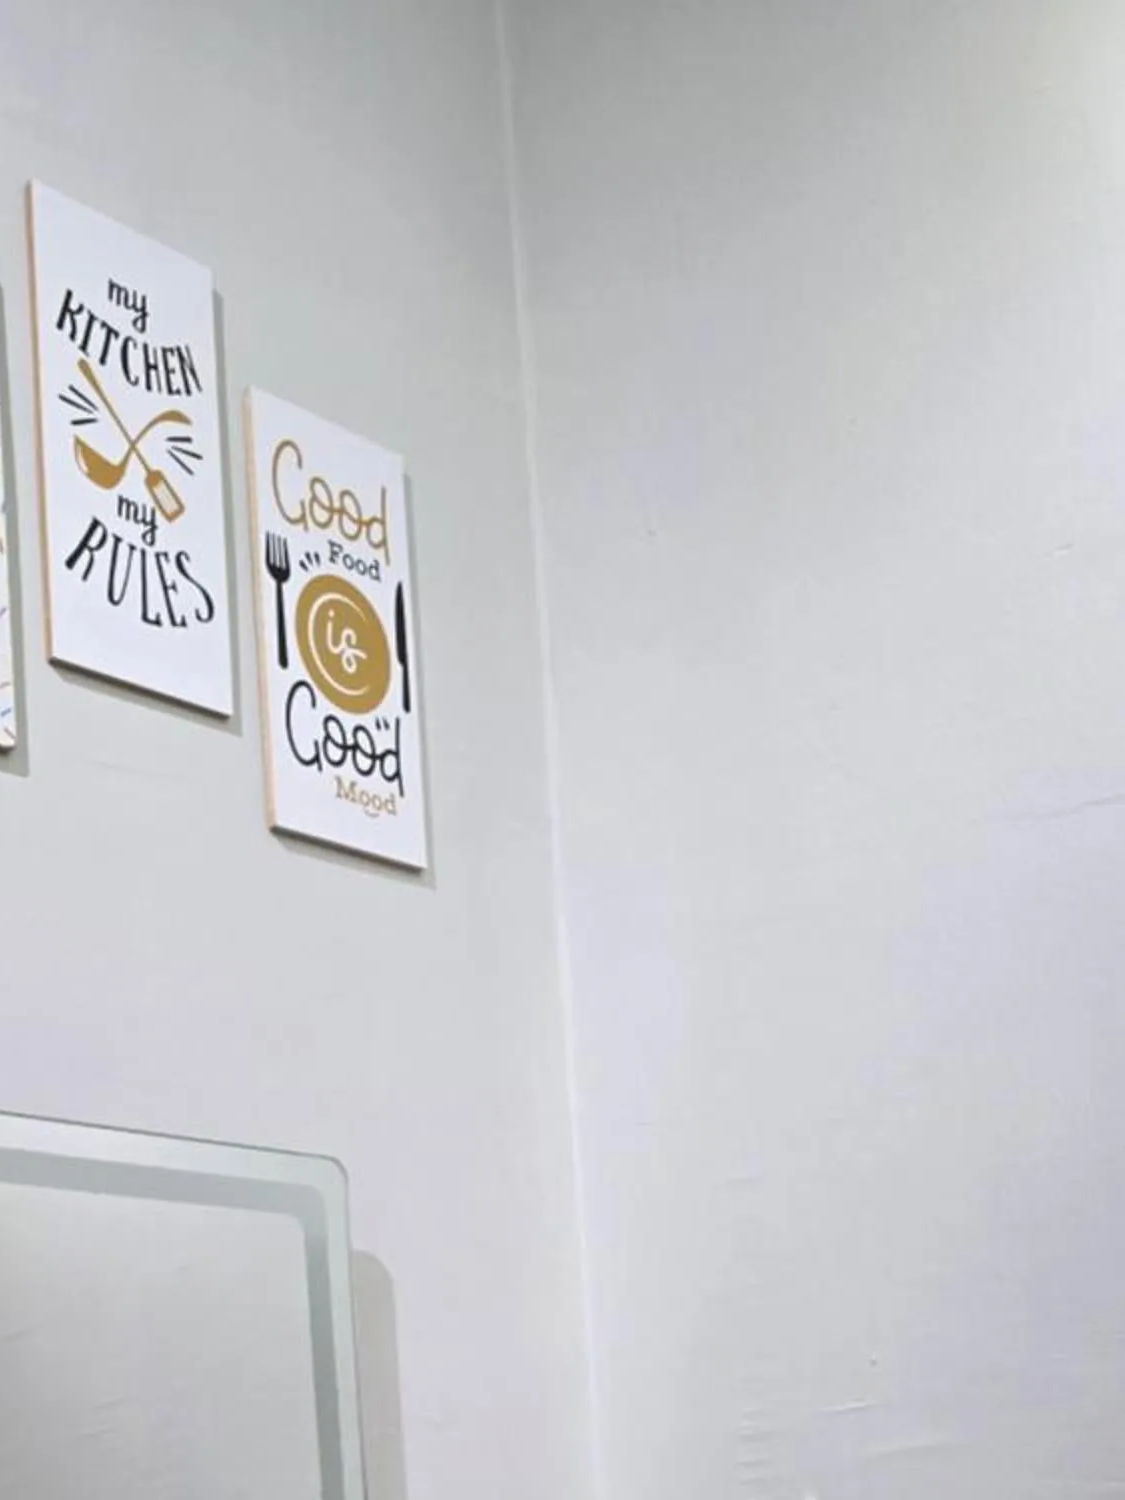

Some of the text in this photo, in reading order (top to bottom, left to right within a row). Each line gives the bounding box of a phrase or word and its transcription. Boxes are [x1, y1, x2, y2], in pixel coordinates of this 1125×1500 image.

[108, 278, 149, 333] my
[56, 288, 202, 397] KITCHEN
[117, 494, 159, 547] my
[272, 439, 390, 566] Good
[64, 516, 215, 628] RULES
[327, 540, 382, 582] Food
[326, 609, 368, 675] is
[286, 680, 405, 798] Good
[334, 775, 398, 815] Mood
